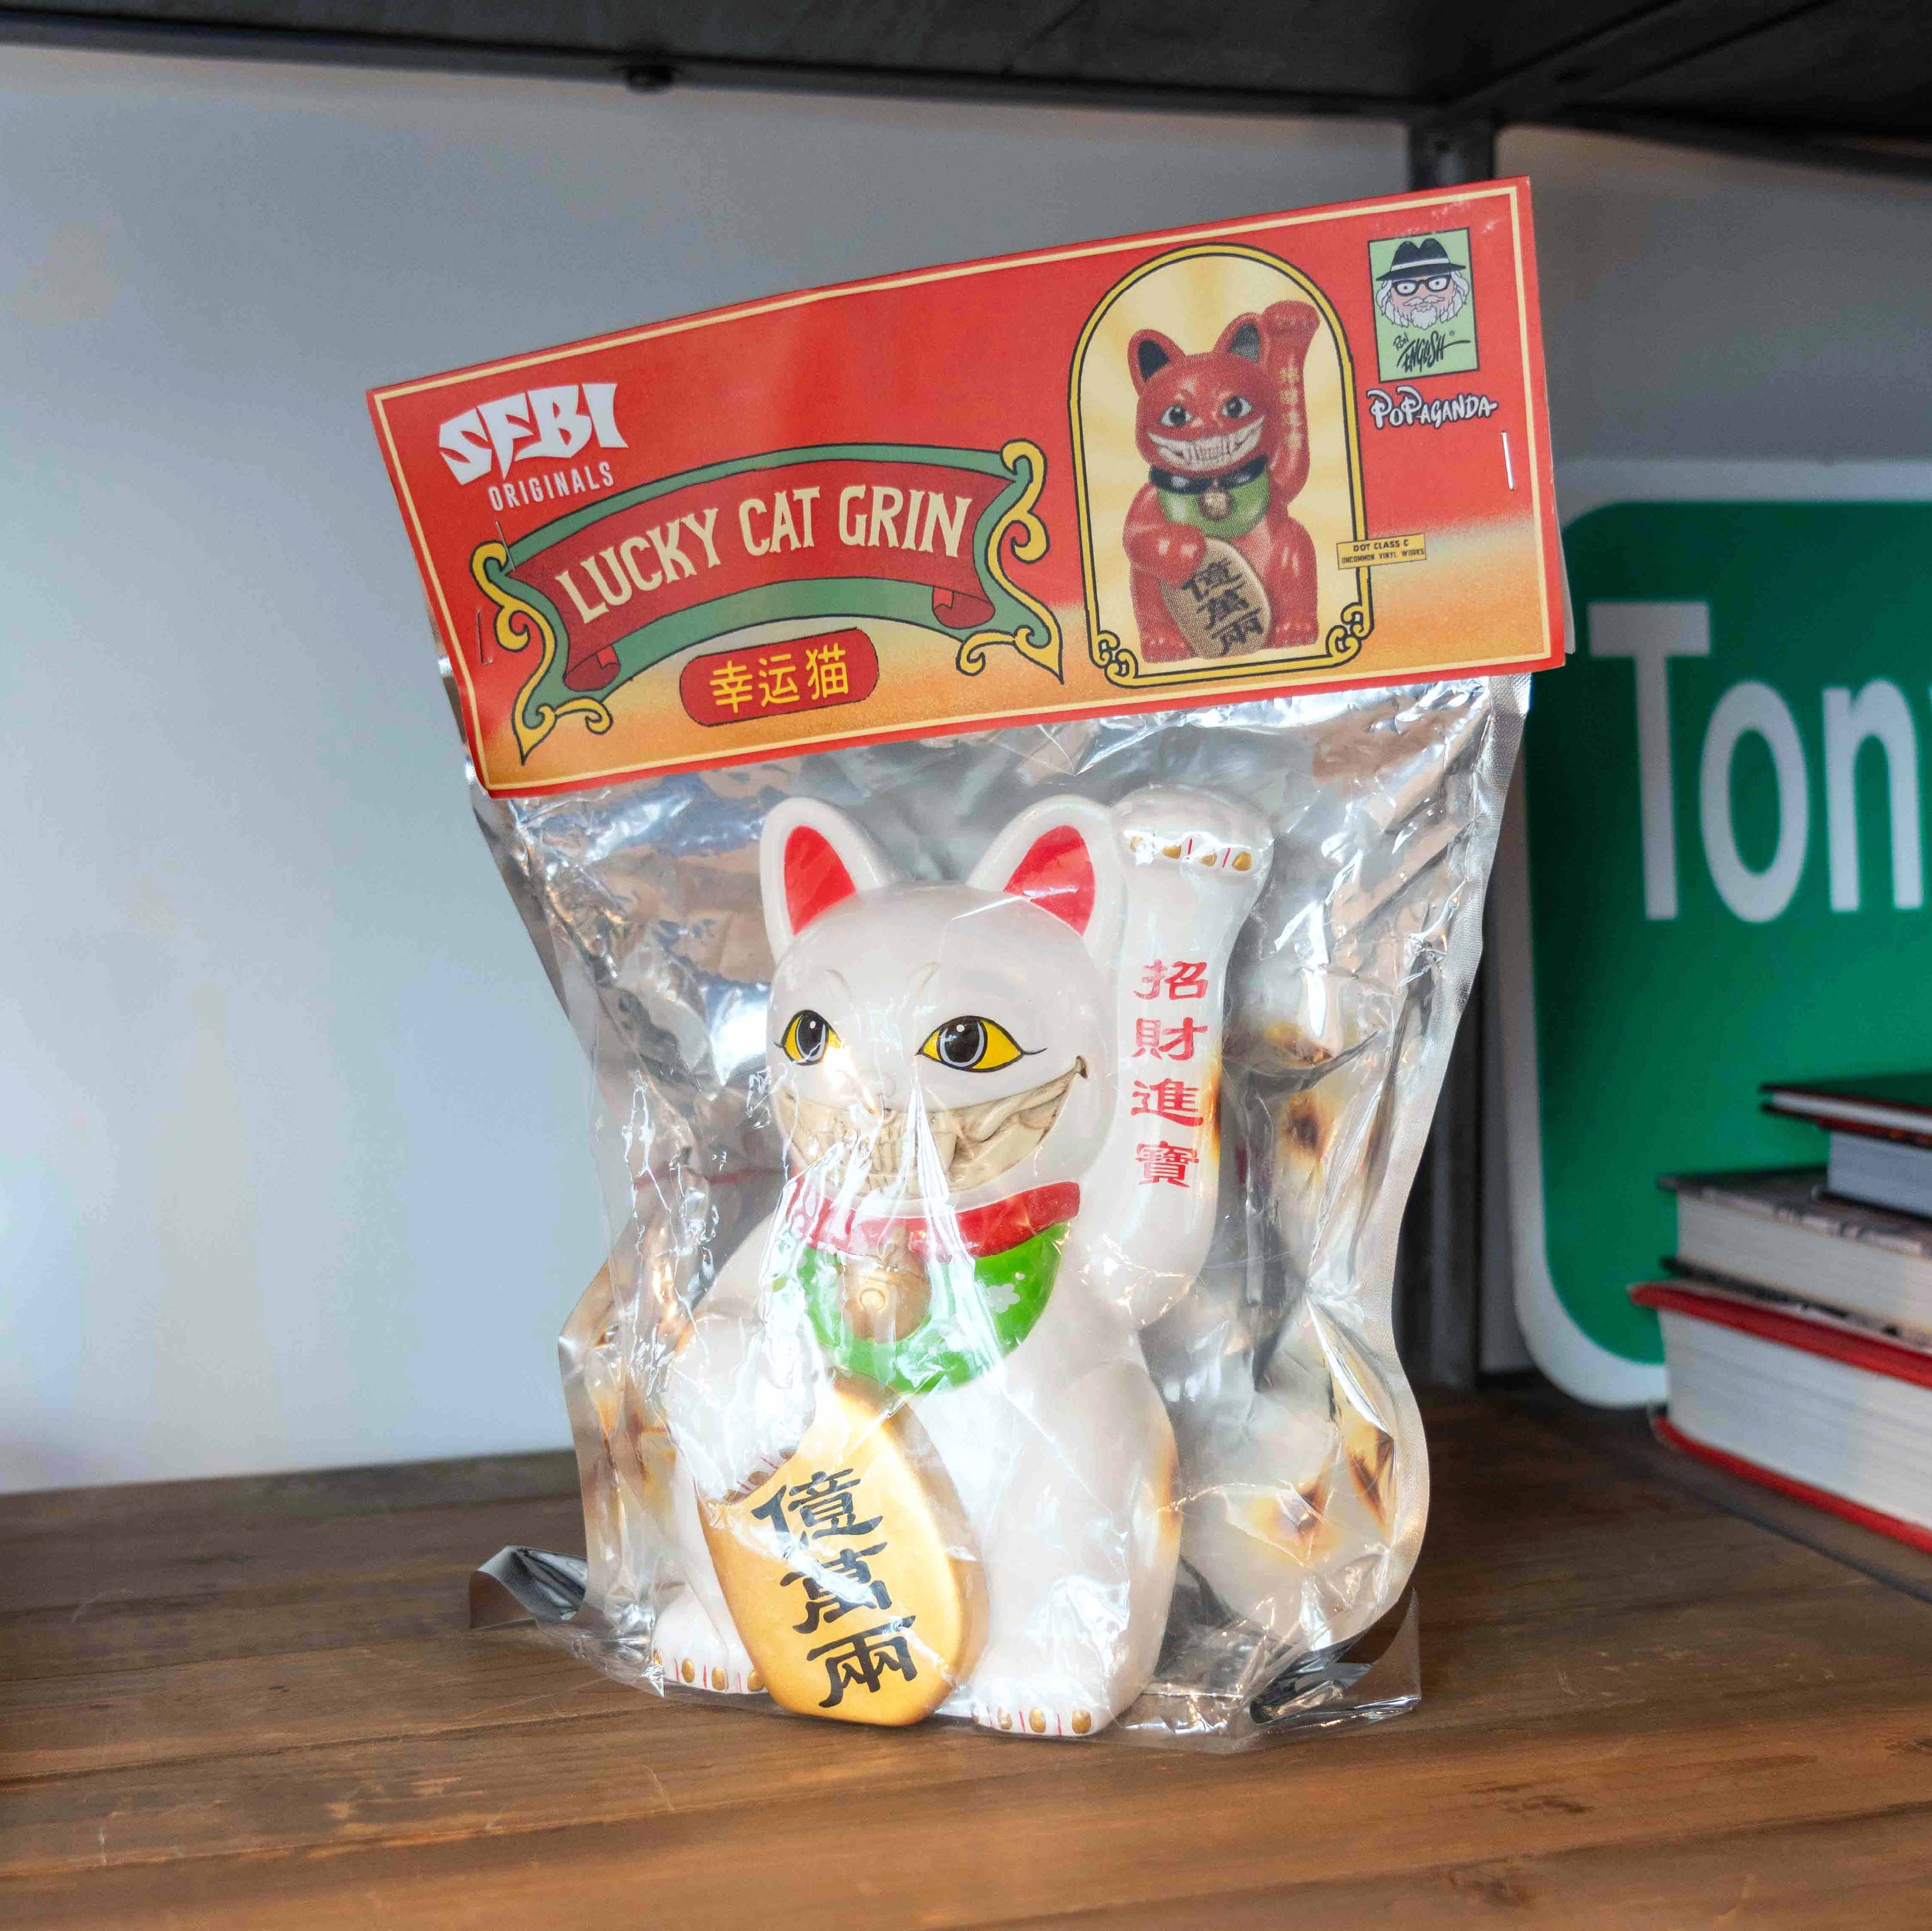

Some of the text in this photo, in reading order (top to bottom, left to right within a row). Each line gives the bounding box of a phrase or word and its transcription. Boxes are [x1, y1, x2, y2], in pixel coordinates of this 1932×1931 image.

[489, 461, 614, 511] ORIGINALS
[555, 484, 972, 624] LUCKY CAT GRIN
[1341, 548, 1424, 564] UNCOMMON VINYL WORKS
[1353, 543, 1371, 552] DOT
[1374, 540, 1400, 550] CLASS
[710, 643, 849, 713] 幸运猫
[1588, 602, 1932, 923] Ton
[1130, 959, 1209, 1188] 招財進寶
[751, 1468, 917, 1707] 億萬兩
